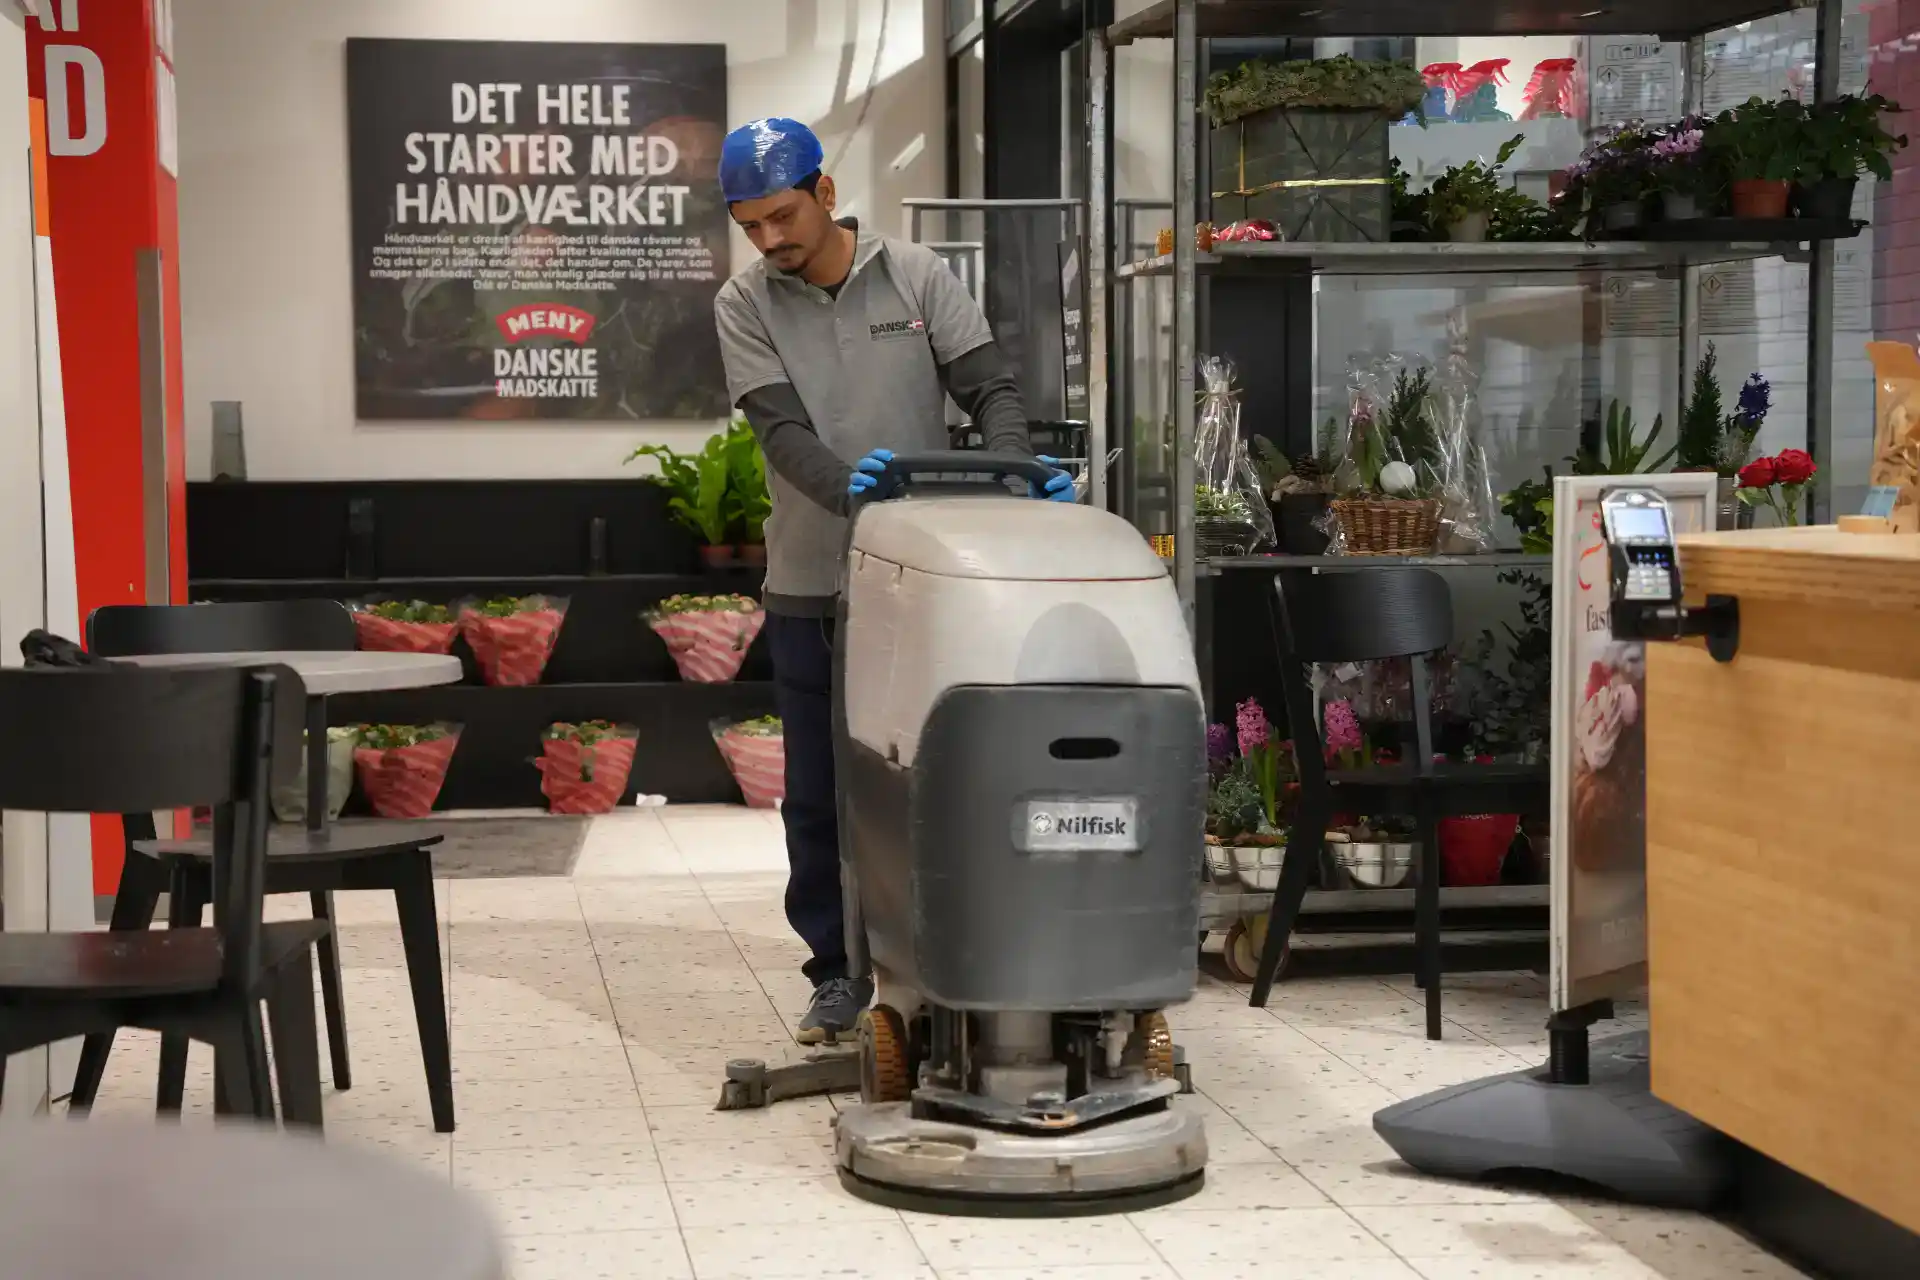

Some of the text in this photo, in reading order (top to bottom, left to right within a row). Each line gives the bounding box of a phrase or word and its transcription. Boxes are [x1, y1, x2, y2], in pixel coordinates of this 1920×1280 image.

[452, 83, 631, 125] DET HELE
[404, 132, 679, 176] STARTER MED
[396, 176, 690, 226] HÅNDVÆRKET
[458, 236, 470, 244] er
[526, 234, 584, 247] kærlighed
[586, 235, 598, 245] til
[600, 235, 640, 245] danske
[643, 234, 683, 245] råvarer
[685, 237, 700, 247] og
[590, 247, 645, 257] kvaliteten
[648, 248, 663, 258] og
[373, 257, 391, 267] Og
[394, 257, 414, 267] det
[416, 259, 429, 267] er
[452, 257, 486, 267] sidste
[545, 258, 564, 268] det
[567, 258, 610, 268] handler
[637, 258, 652, 268] De
[689, 260, 712, 268] som
[369, 270, 412, 280] smager
[514, 270, 538, 279] man
[541, 269, 583, 280] virkelig
[586, 269, 627, 280] glæder
[629, 270, 646, 281] sig
[648, 269, 660, 279] til
[662, 270, 674, 279] at
[496, 282, 509, 290] er
[511, 280, 553, 290] Danske
[506, 309, 585, 336] MENY
[494, 348, 598, 377] DANSKE
[497, 379, 598, 397] MADSKATTE
[1057, 816, 1126, 835] Nilfisk
